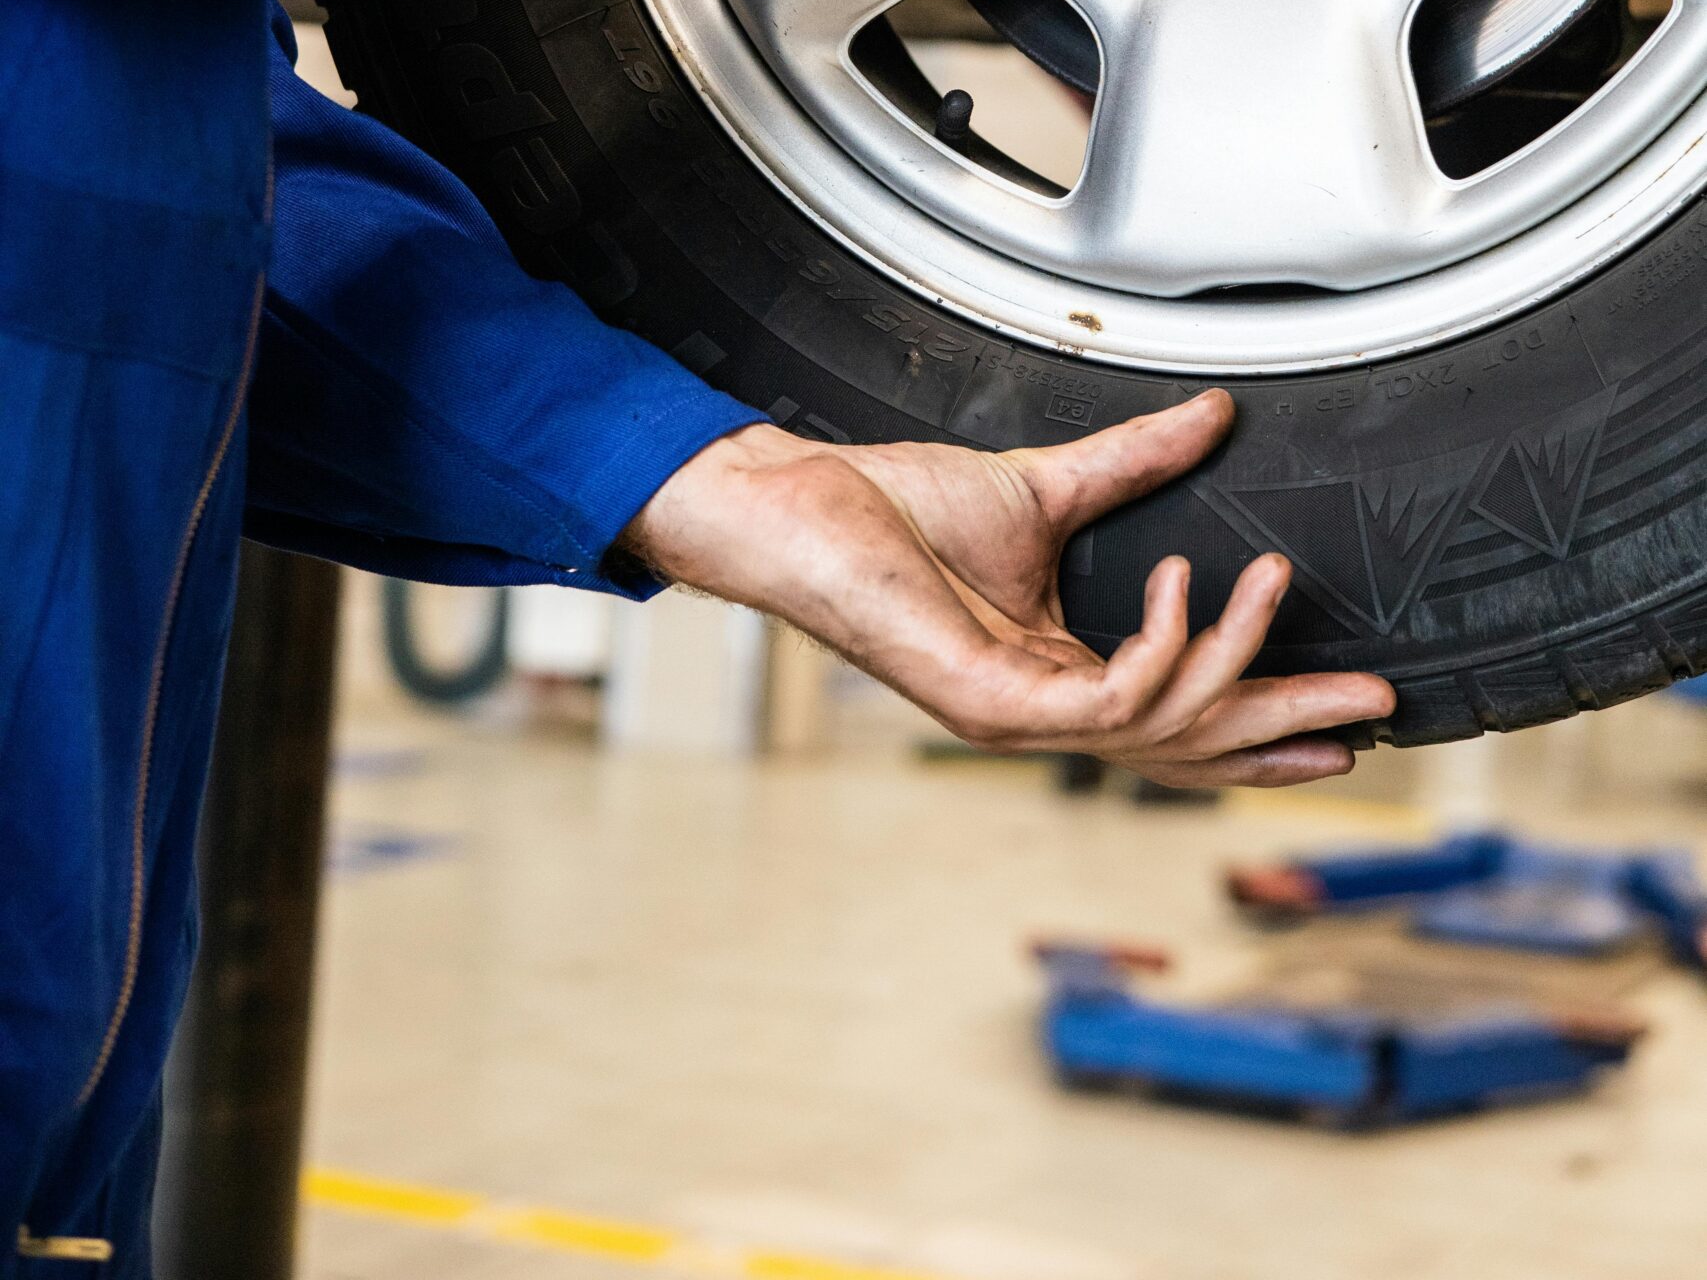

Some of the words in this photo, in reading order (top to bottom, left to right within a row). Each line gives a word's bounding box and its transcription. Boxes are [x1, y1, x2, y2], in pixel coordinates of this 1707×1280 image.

[602, 28, 680, 129] 96T
[1482, 328, 1546, 371] DOT
[1316, 388, 1355, 412] EP
[1376, 362, 1457, 402] 2XCL
[1057, 400, 1085, 419] e4
